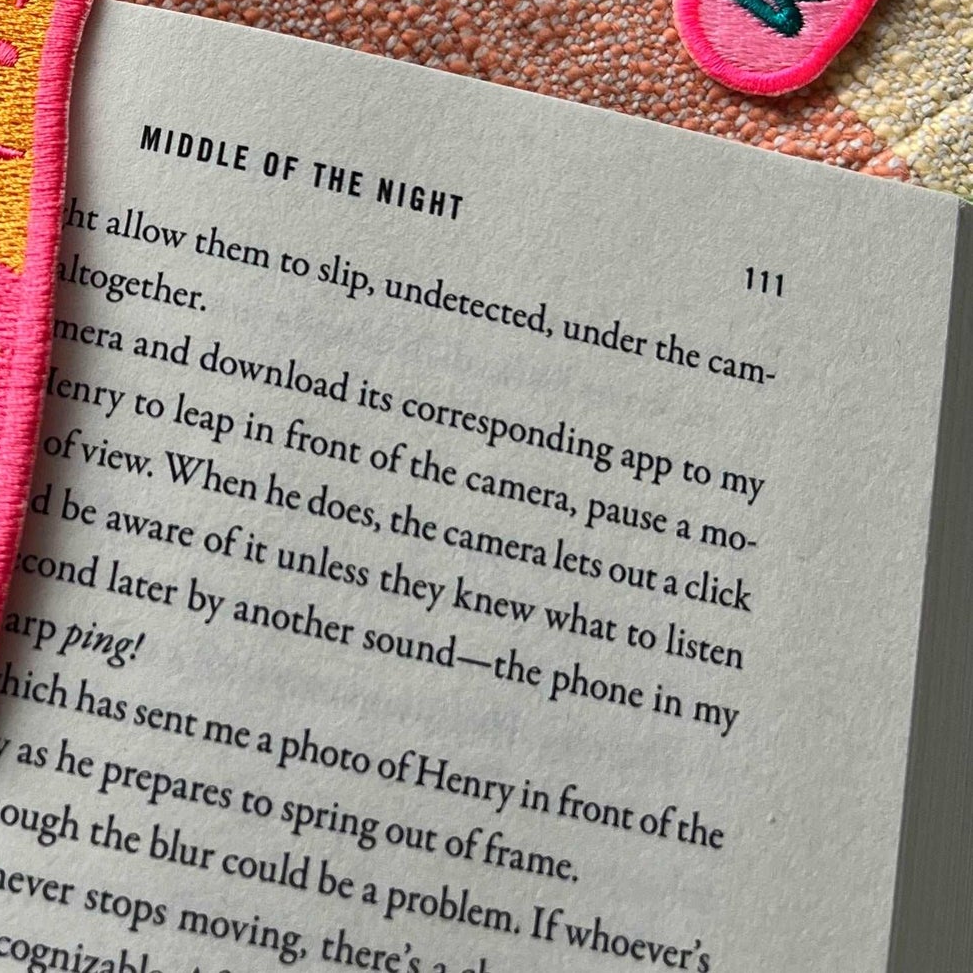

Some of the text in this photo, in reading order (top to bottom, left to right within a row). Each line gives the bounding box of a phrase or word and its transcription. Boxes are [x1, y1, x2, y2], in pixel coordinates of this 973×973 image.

[140, 125, 463, 220] MIDDLE OF THE NIGHT
[106, 209, 187, 248] allow
[196, 227, 269, 268] them
[281, 253, 310, 276] to
[318, 255, 374, 299] slip,
[386, 279, 553, 338] undetected,
[564, 320, 647, 356] under
[656, 334, 700, 368] the
[709, 356, 775, 384] cam-
[746, 267, 783, 297] 111
[53, 318, 123, 351] mera
[134, 335, 190, 365] and
[200, 342, 349, 402] download
[358, 380, 392, 412] its
[402, 399, 614, 472] corresponding
[621, 449, 672, 485] app
[683, 461, 711, 485] to
[720, 472, 765, 506] my
[135, 394, 164, 418] to
[173, 393, 234, 443] leap
[244, 412, 273, 444] in
[284, 419, 360, 464] front
[370, 443, 407, 473] of
[411, 449, 456, 485] the
[466, 473, 576, 517] camera,
[585, 499, 667, 533] pause
[677, 520, 691, 539] a
[700, 525, 756, 550] mo-
[42, 429, 83, 459] of
[81, 440, 152, 477] view.
[165, 451, 256, 501] When
[265, 473, 300, 510] he
[308, 485, 380, 532] does,
[391, 504, 436, 541] the
[444, 527, 546, 566] camera
[553, 539, 602, 578] lets
[609, 564, 657, 591] out
[663, 576, 677, 596] a
[685, 571, 751, 611] click
[62, 488, 96, 525] be
[106, 511, 194, 547] aware
[204, 525, 243, 556] of
[246, 535, 267, 564] it
[278, 546, 369, 587] unless
[381, 562, 445, 612] they
[453, 576, 535, 622] knew
[545, 602, 617, 641] what
[628, 625, 656, 649] to
[665, 623, 742, 669] listen
[57, 622, 145, 668] ping!
[107, 560, 178, 605] later
[188, 577, 225, 624] by
[234, 602, 354, 645] another
[549, 662, 643, 708] phone
[653, 685, 682, 717] in
[693, 702, 739, 737] my
[17, 744, 47, 768] as
[55, 739, 93, 778] he
[98, 762, 232, 808] prepares
[242, 791, 272, 817] to
[281, 802, 379, 851] spring
[386, 824, 437, 852] out
[445, 828, 483, 860] of
[482, 831, 578, 884] frame.
[75, 679, 127, 721] has
[134, 705, 197, 736] sent
[203, 721, 250, 748] me
[257, 733, 272, 753] a
[277, 728, 370, 774] photo
[378, 750, 415, 783] of
[414, 754, 515, 814] Henry
[520, 780, 549, 812] in
[558, 784, 633, 830] front
[640, 806, 677, 836] of
[677, 811, 724, 850] the
[85, 890, 166, 932] stops
[178, 910, 306, 965] moving,
[322, 929, 420, 973] there's
[91, 814, 140, 853] the
[150, 824, 215, 869] blur
[222, 852, 310, 890] could
[318, 860, 354, 899] be
[362, 883, 377, 904] a
[384, 885, 520, 934] problem.
[531, 906, 564, 942] If
[565, 916, 710, 973] whoever's
